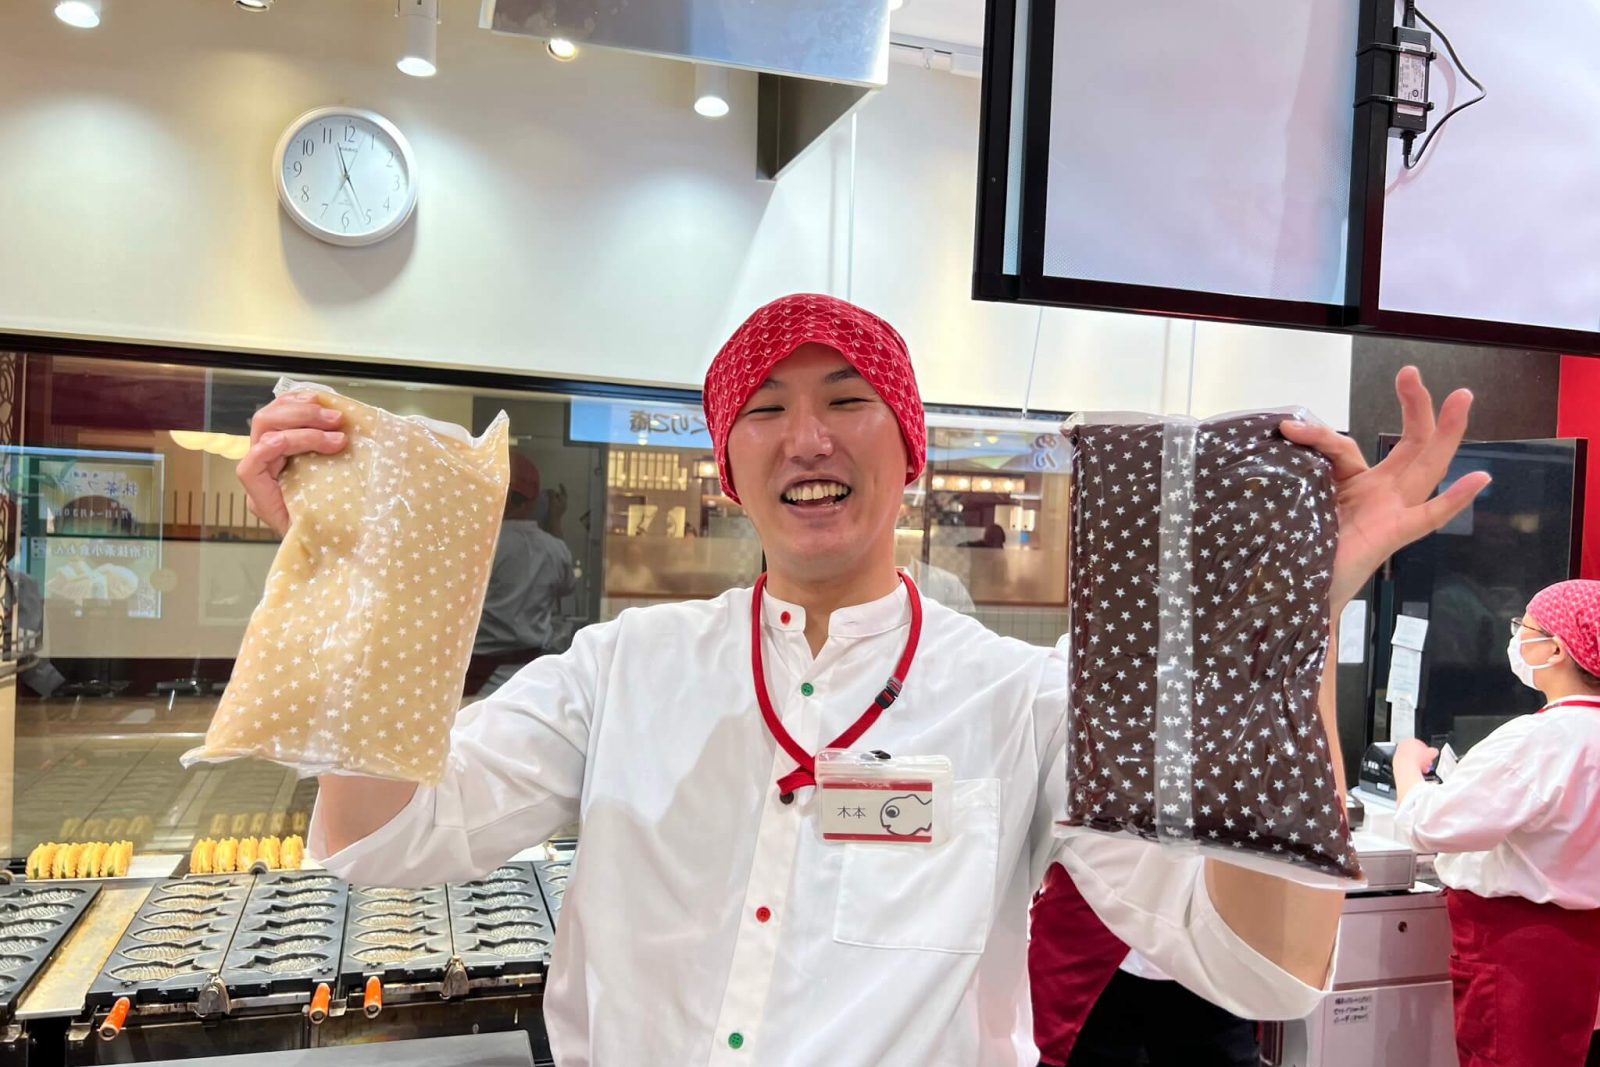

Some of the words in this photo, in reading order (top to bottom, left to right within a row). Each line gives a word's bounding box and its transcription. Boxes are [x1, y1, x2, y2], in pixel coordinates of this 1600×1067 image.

[322, 127, 332, 144] 11
[344, 125, 356, 143] 12
[370, 133, 375, 150] 1
[302, 139, 315, 156] 10
[386, 150, 394, 168] 2
[293, 160, 303, 178] 9
[394, 174, 400, 191] 3
[301, 185, 310, 203] 8
[320, 203, 329, 219] 7
[383, 196, 390, 213] 4
[341, 210, 350, 228] 6
[365, 208, 372, 225] 5
[837, 806, 866, 819] 木本
